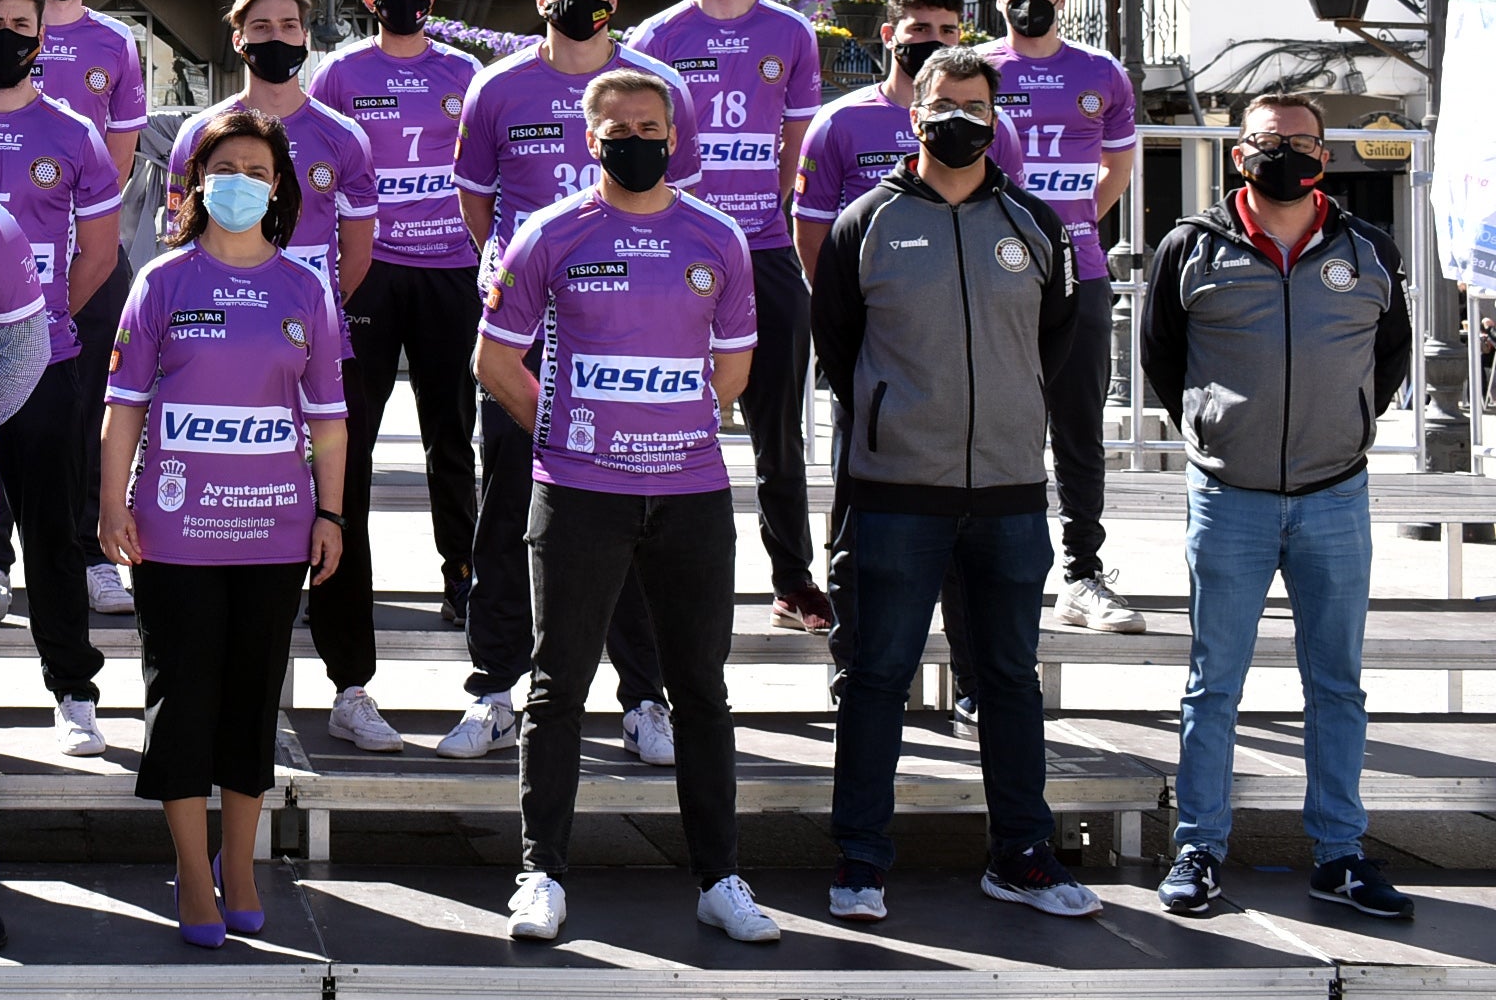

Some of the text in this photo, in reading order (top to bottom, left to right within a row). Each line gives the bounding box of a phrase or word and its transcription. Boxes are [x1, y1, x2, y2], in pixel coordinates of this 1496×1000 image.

[361, 111, 400, 120] UCLM
[710, 90, 747, 128] 18
[402, 127, 423, 162] 7
[1024, 125, 1065, 158] 17
[518, 144, 565, 155] UCLM
[701, 139, 772, 162] estas
[1365, 143, 1405, 157] Galicia
[1025, 170, 1095, 193] stas
[705, 193, 778, 203] Ayuntamiento
[720, 201, 758, 211] Ciudad
[392, 217, 461, 229] Ayuntamiento
[391, 225, 463, 238] de Ciudad Rea
[577, 281, 629, 292] UCLM
[178, 328, 226, 339] UCLM
[574, 361, 701, 393] Vestas
[165, 411, 294, 444] Vestas
[611, 430, 708, 443] Ayuntamiento
[609, 442, 684, 453] de Ciudad
[594, 459, 682, 474] #somosiguales
[203, 482, 296, 496] Ayuntamiento
[199, 494, 298, 508] de Ciudad Real
[183, 515, 276, 528] #somosdistintas
[182, 526, 269, 542] #somosiguales
